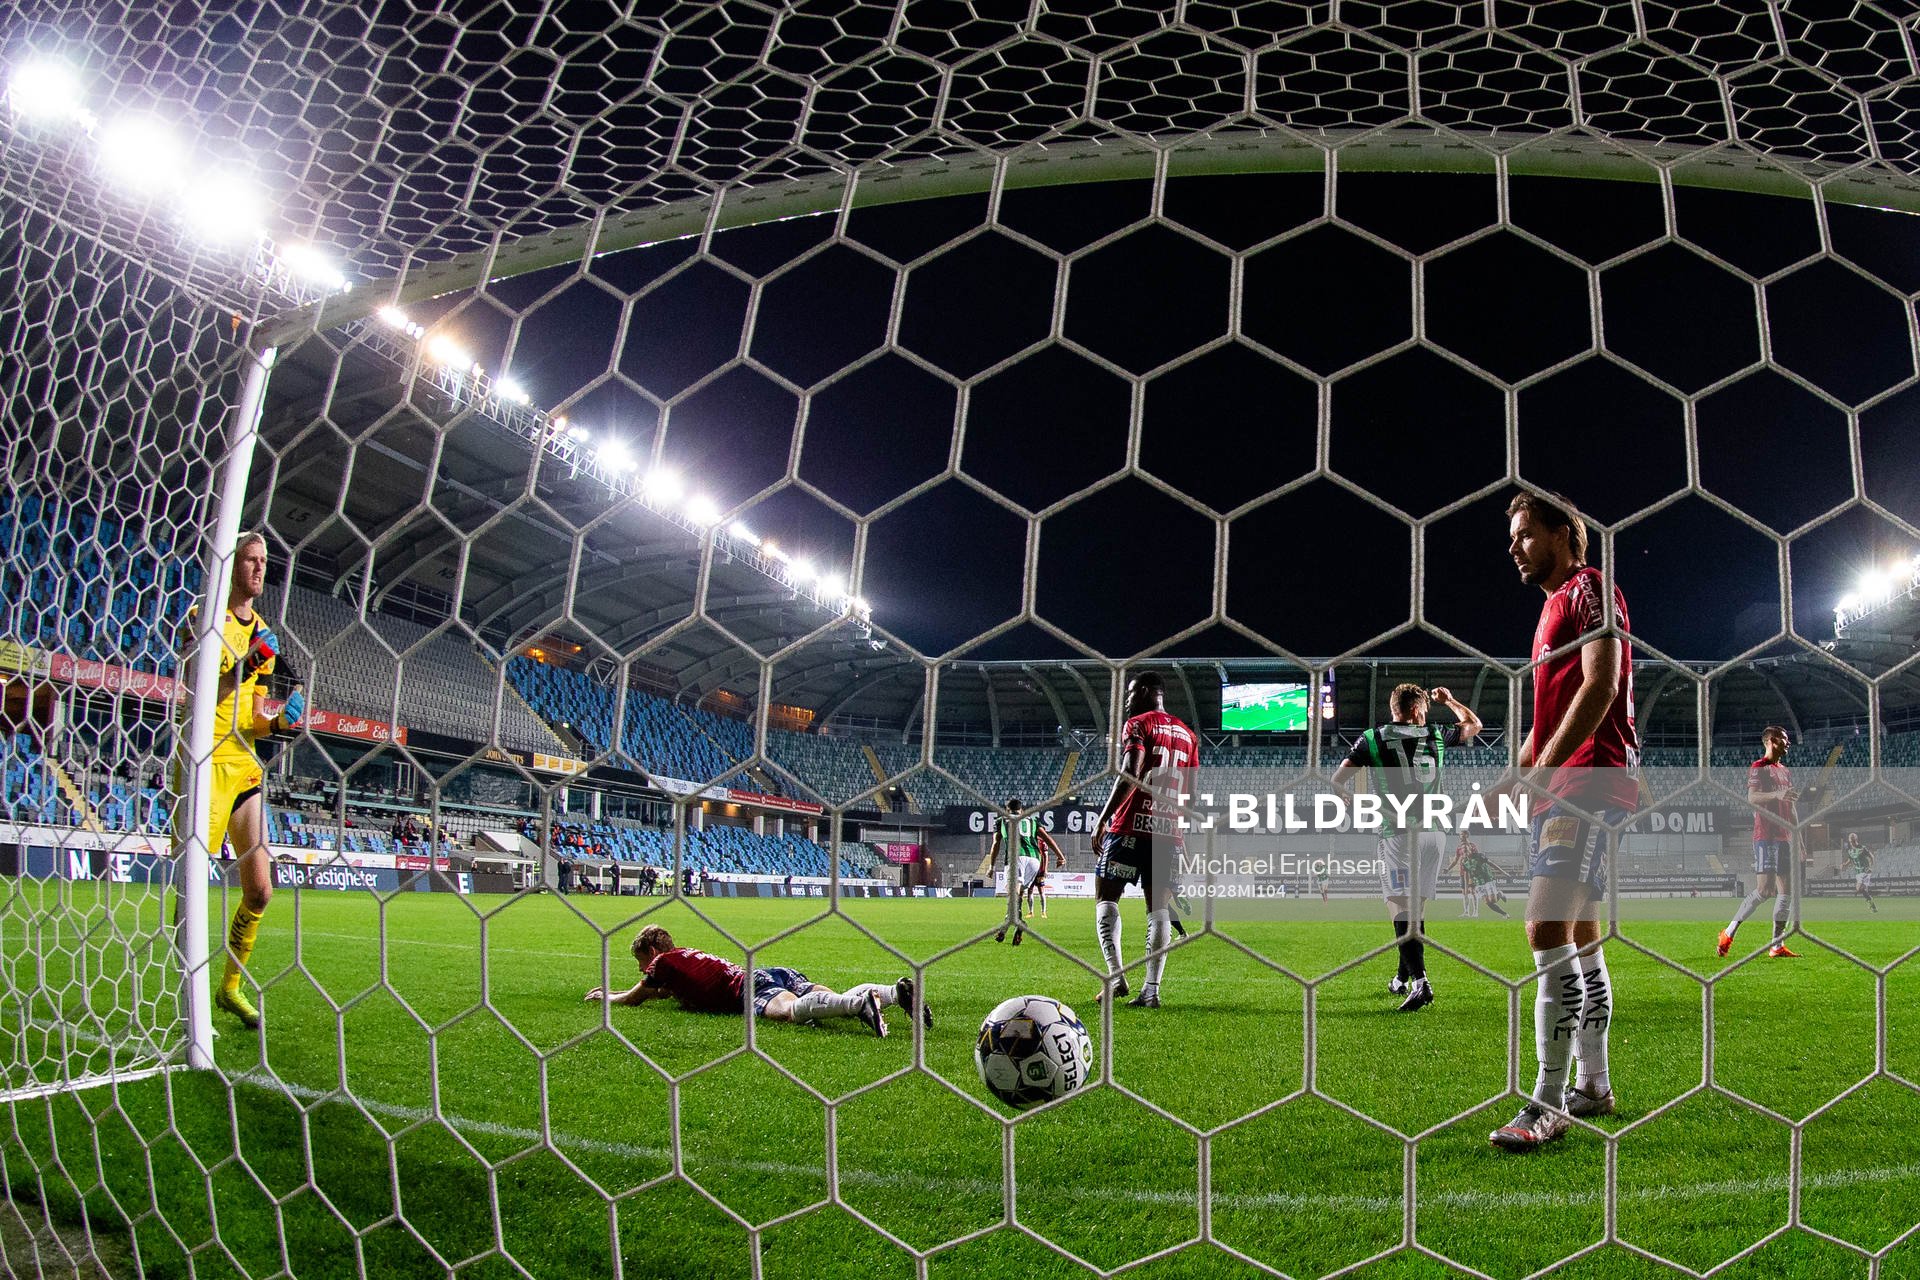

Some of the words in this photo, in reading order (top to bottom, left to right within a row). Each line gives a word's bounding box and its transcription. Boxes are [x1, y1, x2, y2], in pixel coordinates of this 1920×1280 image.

[337, 718, 369, 734] Estrella
[1650, 812, 1715, 833] DOM!
[1554, 973, 1584, 1041] MIKE
[1583, 967, 1610, 1032] MIKE
[1053, 1033, 1078, 1092] SELECT
